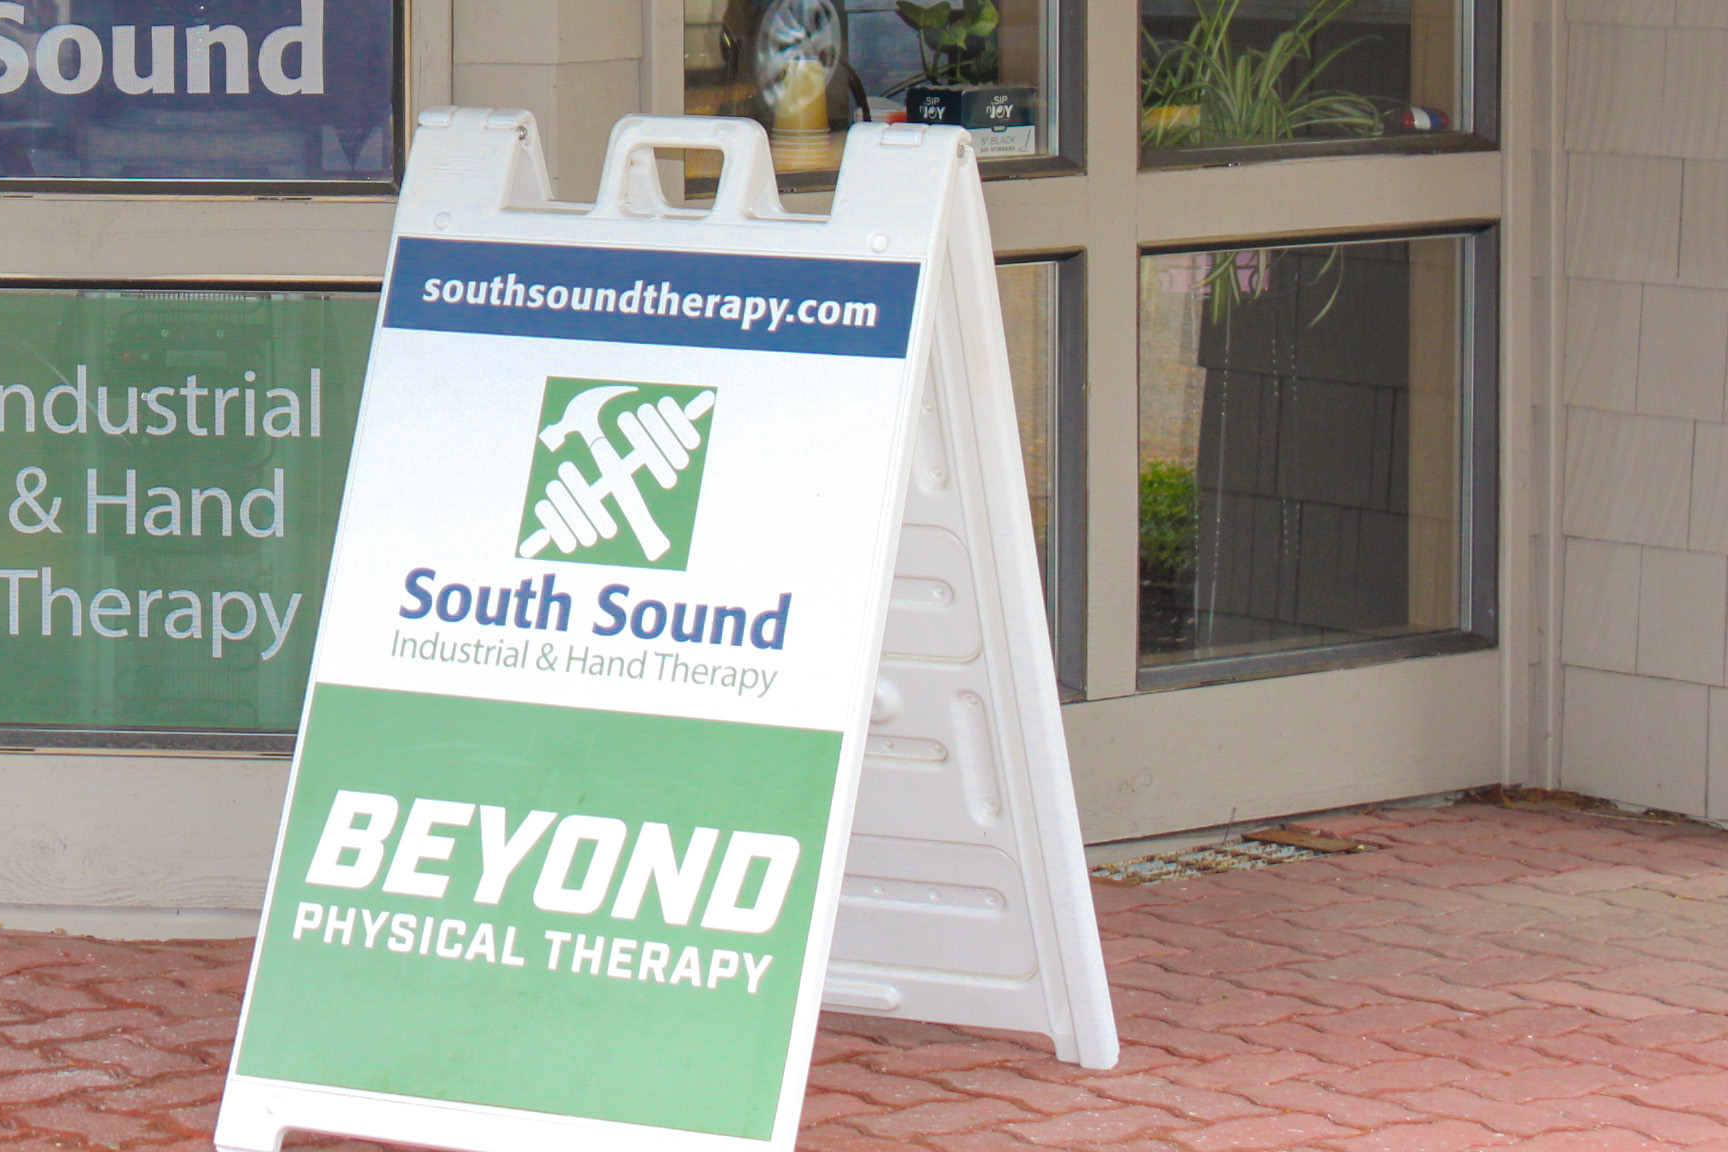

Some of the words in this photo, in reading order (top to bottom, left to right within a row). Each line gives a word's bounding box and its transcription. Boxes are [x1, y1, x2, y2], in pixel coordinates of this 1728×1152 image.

[925, 96, 940, 105] SIP
[994, 96, 1008, 105] SIP
[991, 136, 1016, 145] BLACK
[422, 272, 878, 333] southsoundtherapy.com
[8, 465, 63, 535] &
[86, 467, 285, 538] Hand
[398, 566, 573, 632] South
[592, 583, 793, 651] Sound
[390, 628, 530, 670] Industrial
[535, 642, 559, 673] &
[564, 643, 648, 681] Hand
[653, 651, 779, 699] Therapy
[304, 788, 802, 935] BEYOND
[291, 901, 526, 968] PHYSICAL
[544, 929, 774, 995] THERAPY
